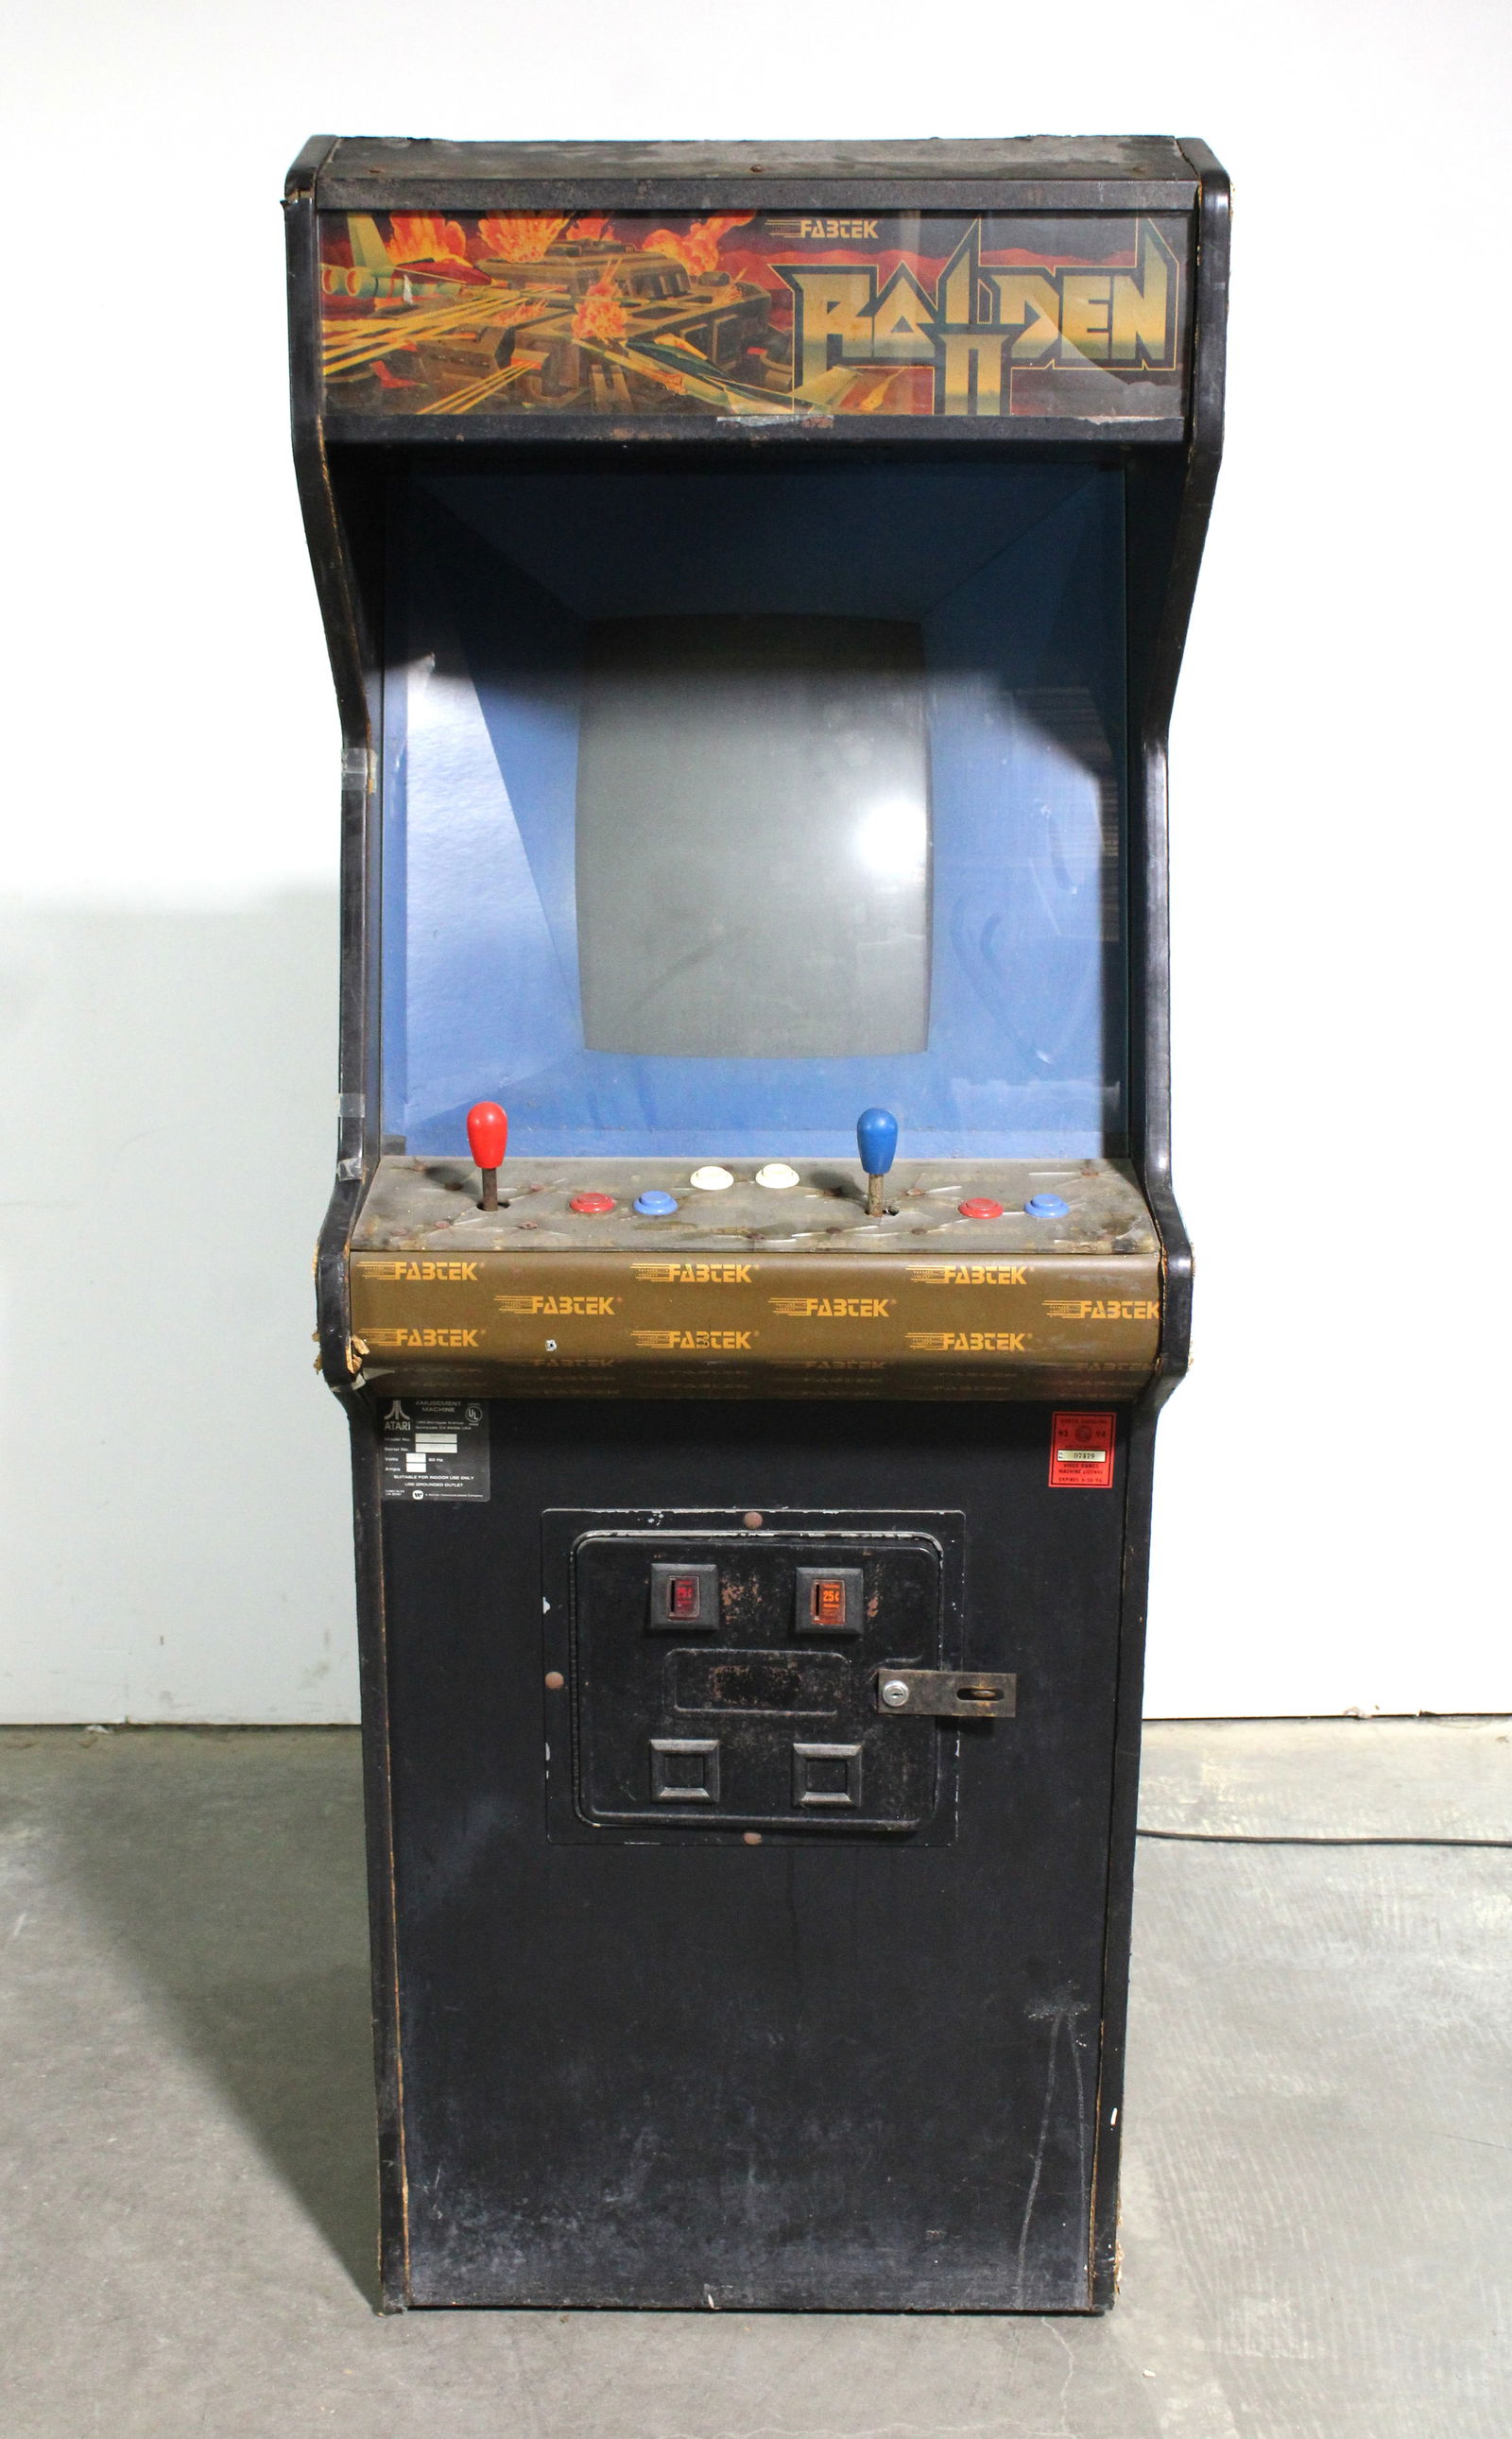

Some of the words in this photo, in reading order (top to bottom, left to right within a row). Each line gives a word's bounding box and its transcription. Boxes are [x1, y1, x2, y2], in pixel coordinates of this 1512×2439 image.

[800, 219, 879, 238] FABTEK
[788, 232, 1170, 395] RAIDEN
[394, 1262, 479, 1280] FABTEK
[668, 1263, 753, 1283] FABTEK
[943, 1265, 1028, 1284] FABTEK
[532, 1296, 616, 1315] FABTEK
[806, 1297, 890, 1317] FABTEK
[396, 1329, 479, 1348] FABTEK
[669, 1331, 753, 1349] FABTEK
[943, 1332, 1027, 1351] FABTEK
[384, 1421, 411, 1431] ATARI
[823, 1590, 840, 1603] 25¢
